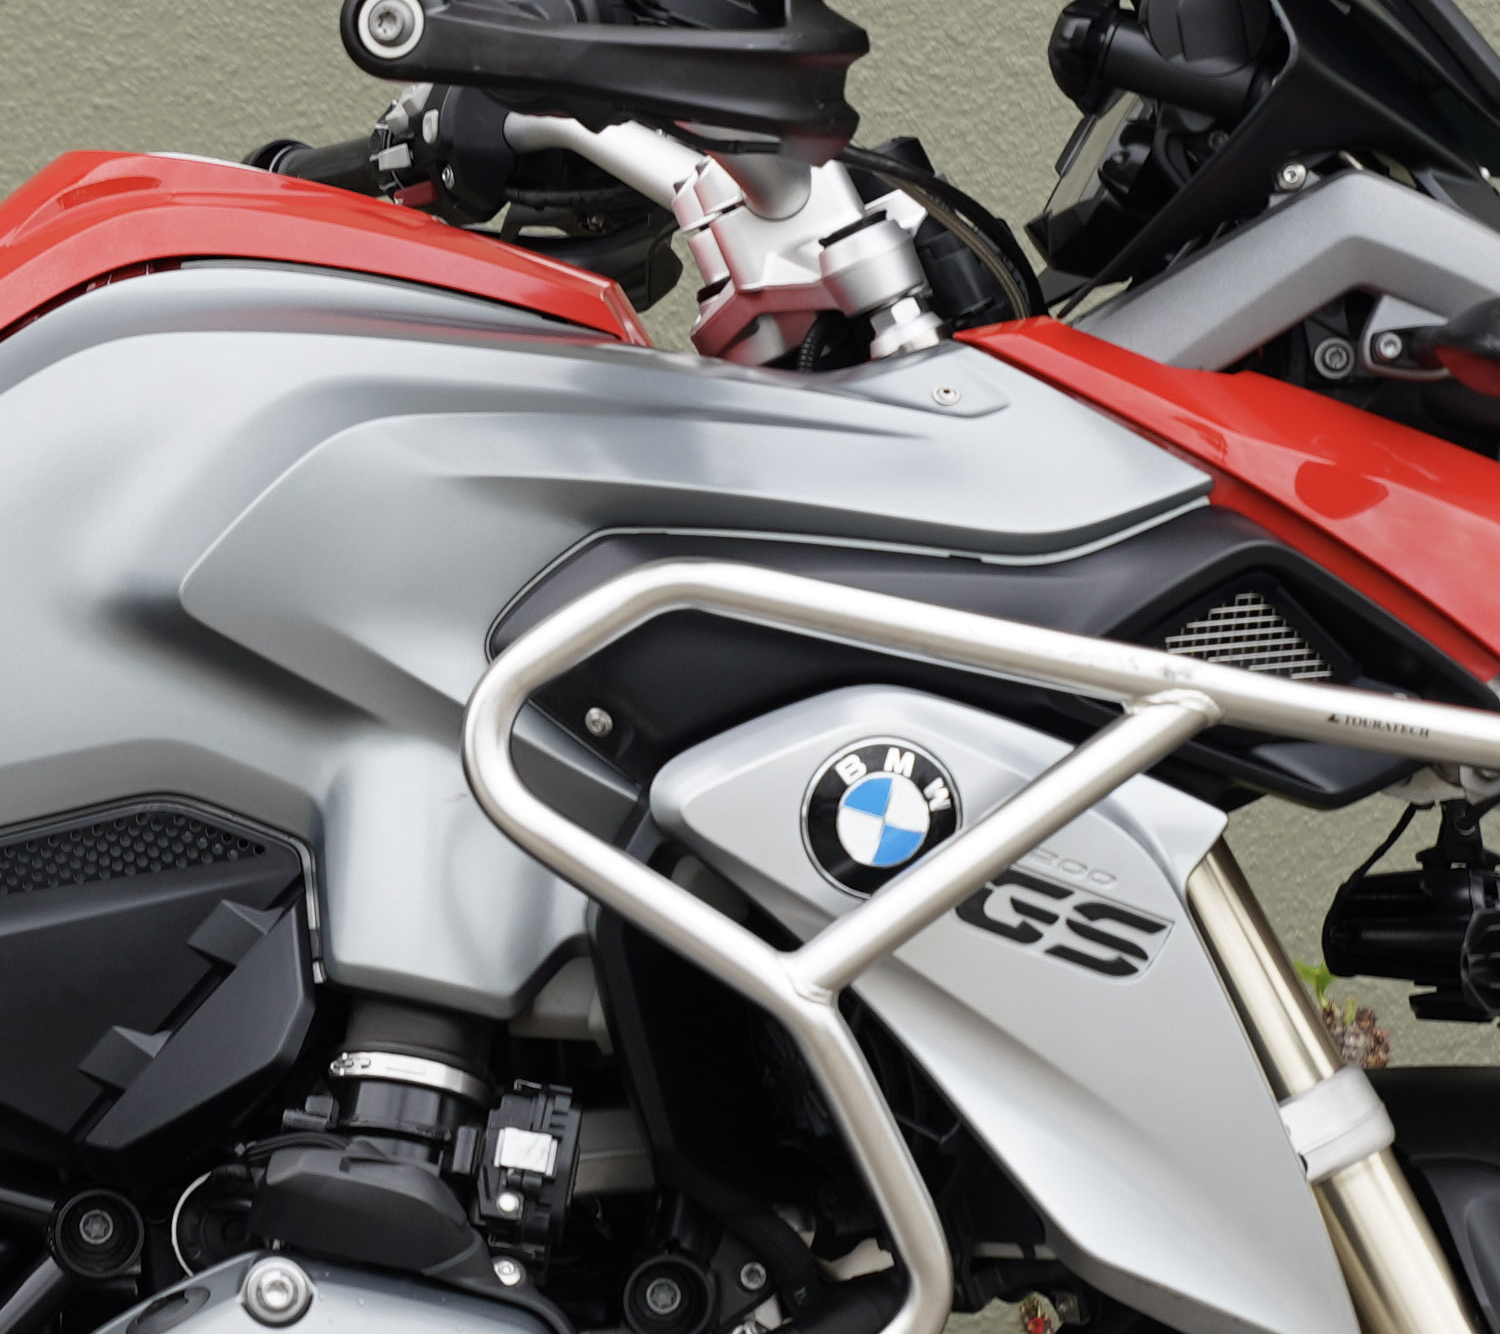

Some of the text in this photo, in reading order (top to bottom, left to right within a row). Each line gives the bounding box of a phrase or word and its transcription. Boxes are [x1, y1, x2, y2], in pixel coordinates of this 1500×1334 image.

[1343, 714, 1430, 740] TOURATECH
[836, 747, 955, 813] BMW
[1029, 846, 1117, 887] 200
[955, 869, 1168, 977] GS
